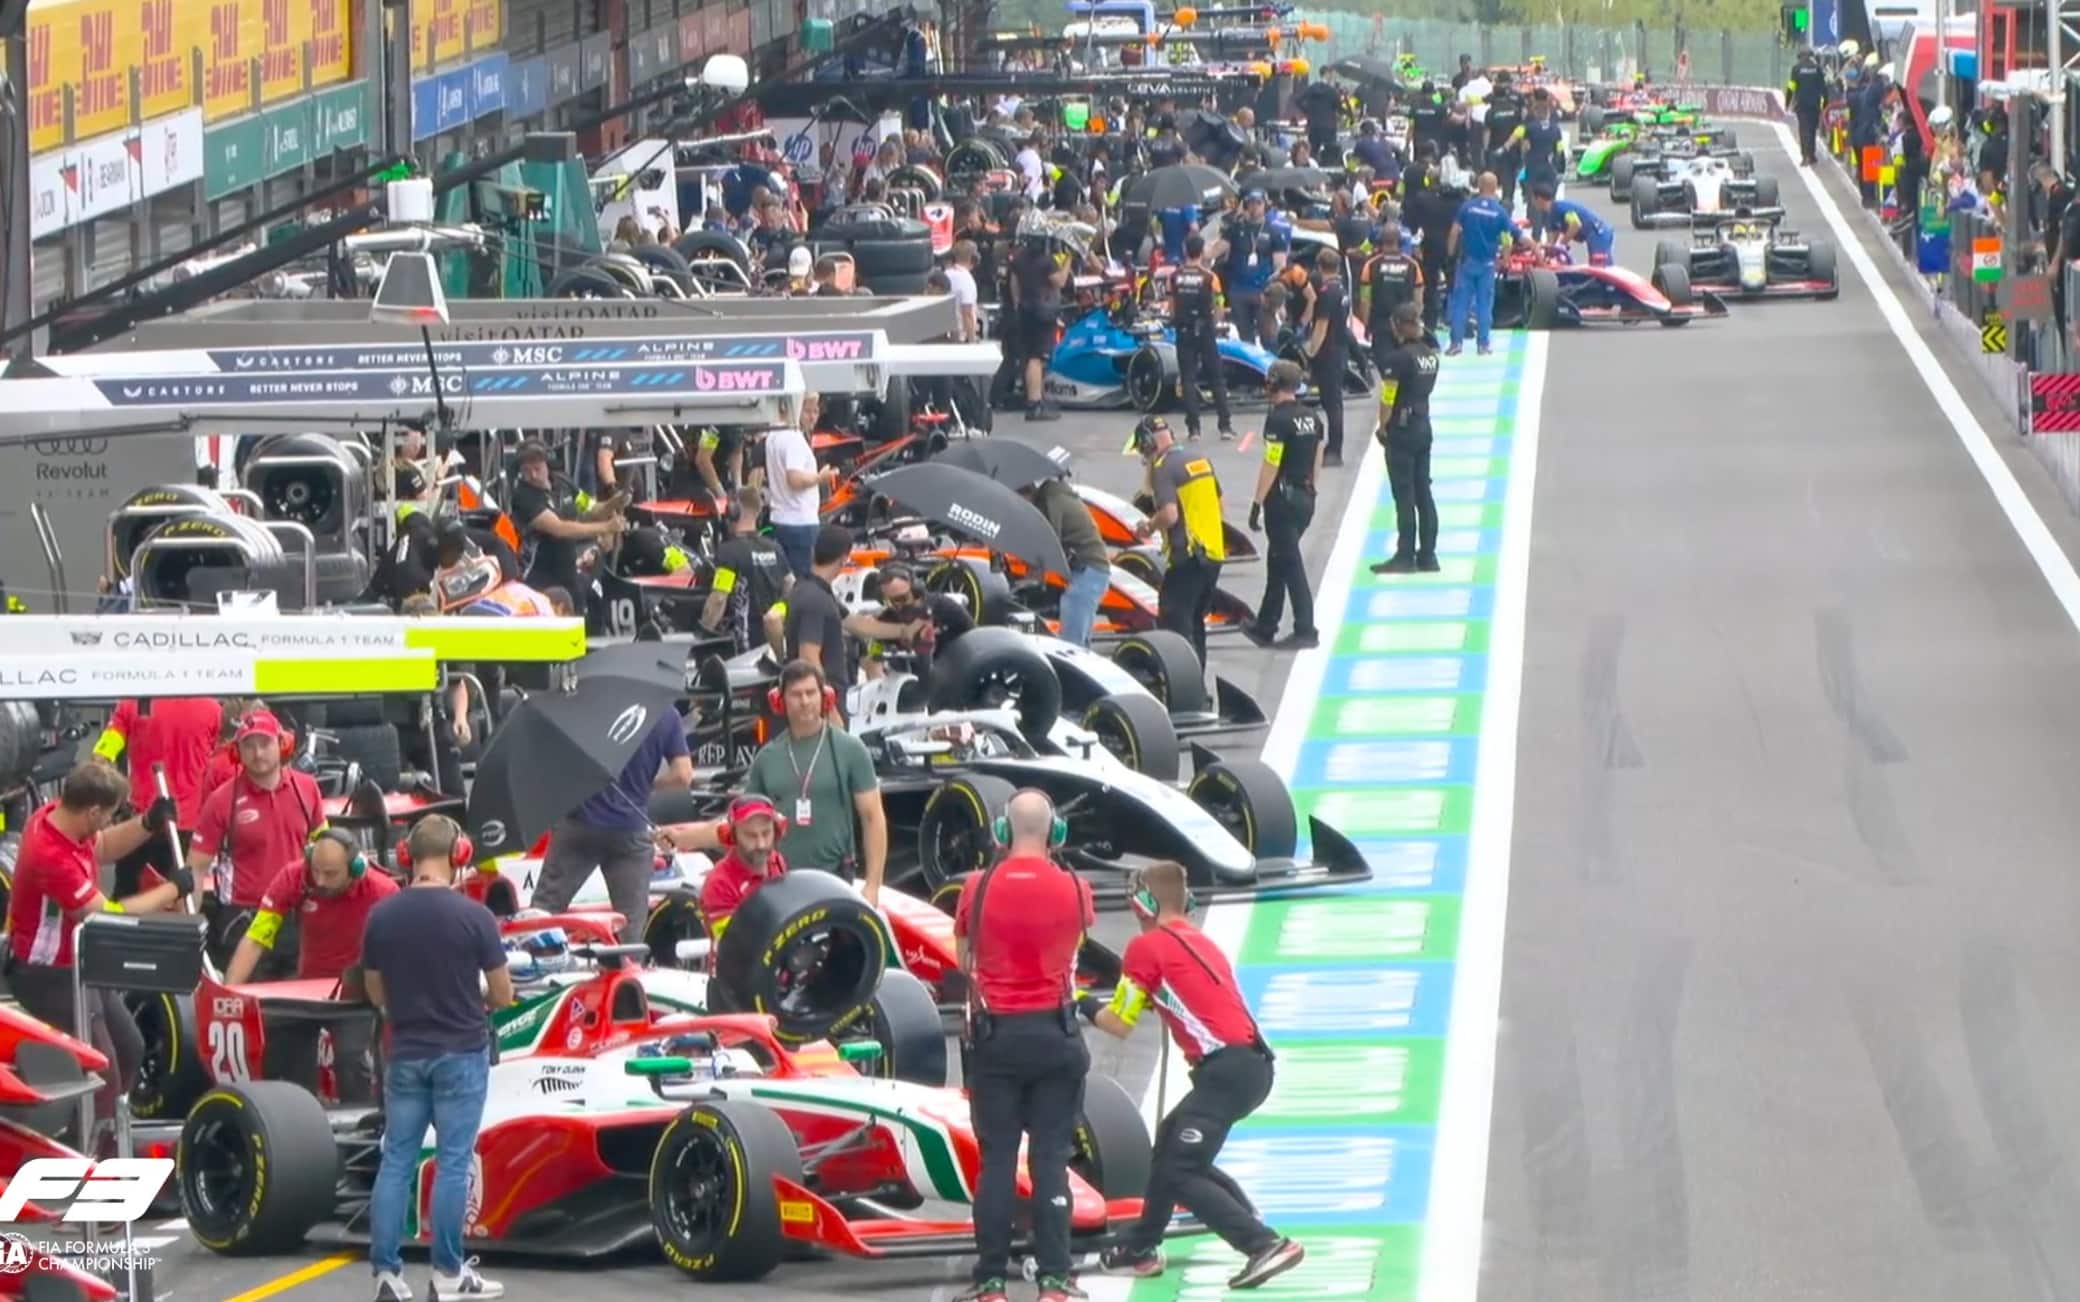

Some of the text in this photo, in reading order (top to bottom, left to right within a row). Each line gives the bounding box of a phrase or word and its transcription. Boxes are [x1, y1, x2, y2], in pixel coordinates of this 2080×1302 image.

[512, 347, 563, 363] MSC
[637, 342, 714, 353] ALPINE
[809, 341, 861, 358] BWT
[250, 384, 287, 394] BETTER
[291, 383, 323, 393] NEVER
[541, 371, 620, 381] ALPINE
[718, 371, 773, 389] BWT
[36, 463, 108, 480] Revolut
[179, 521, 228, 538] ZERO
[950, 503, 1001, 534] RODIN
[610, 598, 638, 637] 19
[113, 632, 250, 648] CADILLAC
[261, 634, 336, 645] FORMULA
[354, 634, 395, 645] TEAM
[0, 668, 78, 685] LLAC
[91, 670, 176, 680] FORMULA
[197, 668, 244, 679] TEAM
[773, 907, 828, 951] ZERO
[208, 1020, 251, 1087] 20
